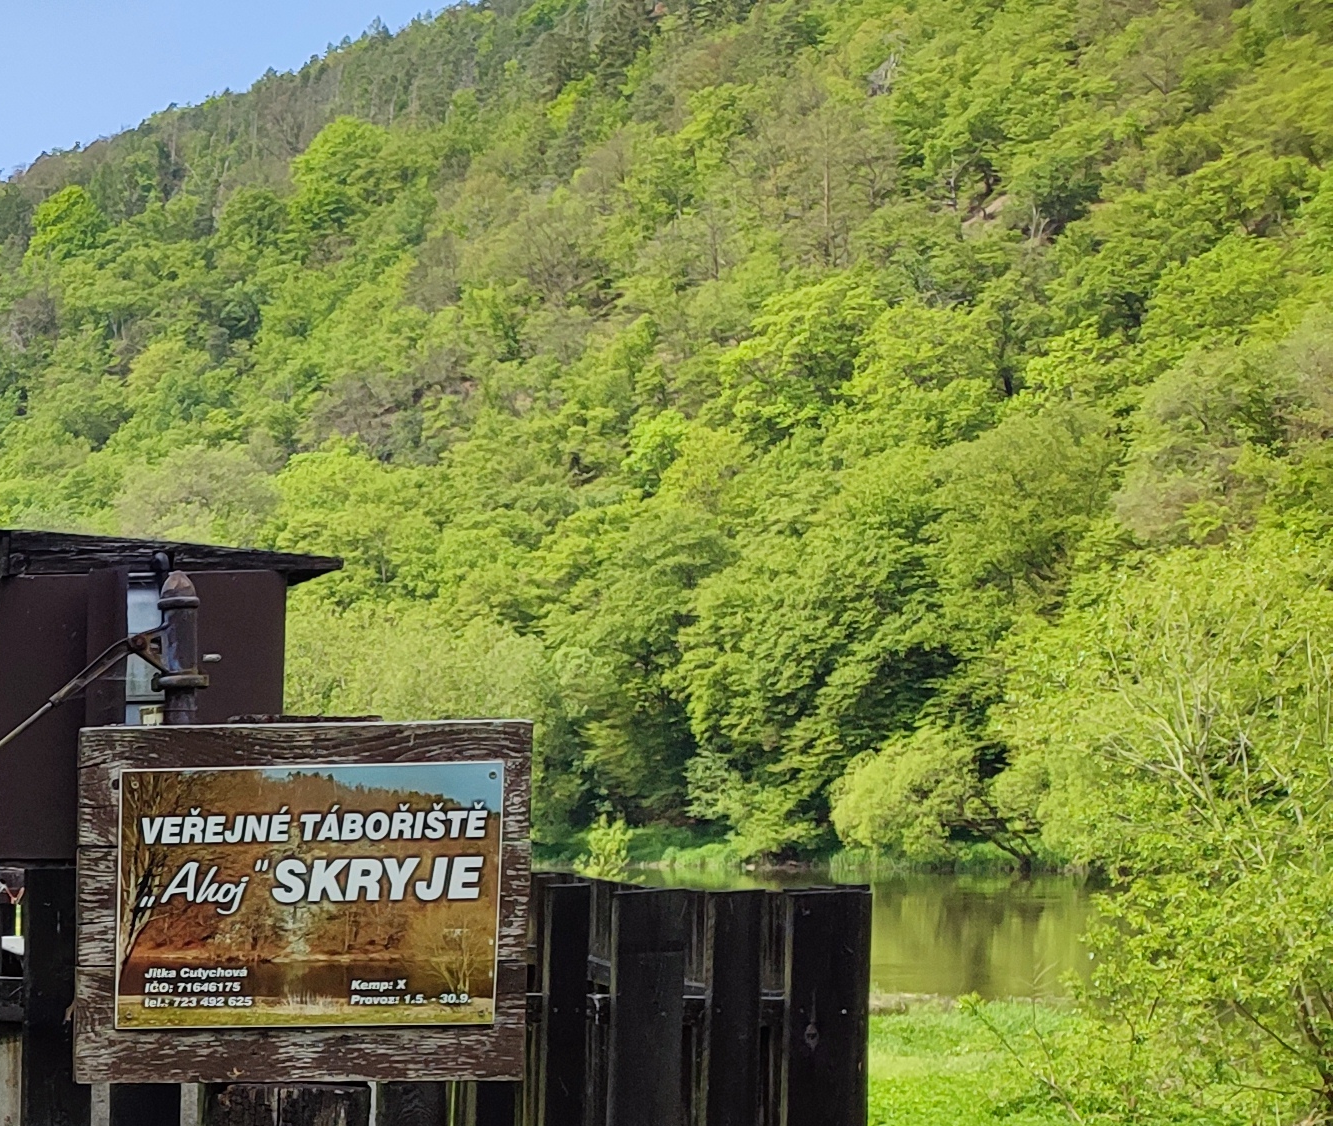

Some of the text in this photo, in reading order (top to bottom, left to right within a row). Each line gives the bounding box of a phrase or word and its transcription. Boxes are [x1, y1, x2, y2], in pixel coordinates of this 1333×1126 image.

[141, 802, 488, 845] VEŘEJNÉ TÁBOŘIŠTĚ
[271, 856, 484, 904] SKRYJE
[144, 967, 177, 979] Jitka
[177, 981, 242, 993] 71646175
[350, 979, 407, 992] Kemp: X
[173, 997, 198, 1008] 723
[199, 996, 225, 1007] 492
[227, 996, 253, 1007] 625
[350, 994, 401, 1005] Provoz:
[403, 993, 428, 1004] 1.5.
[438, 993, 472, 1004] 30.9.
